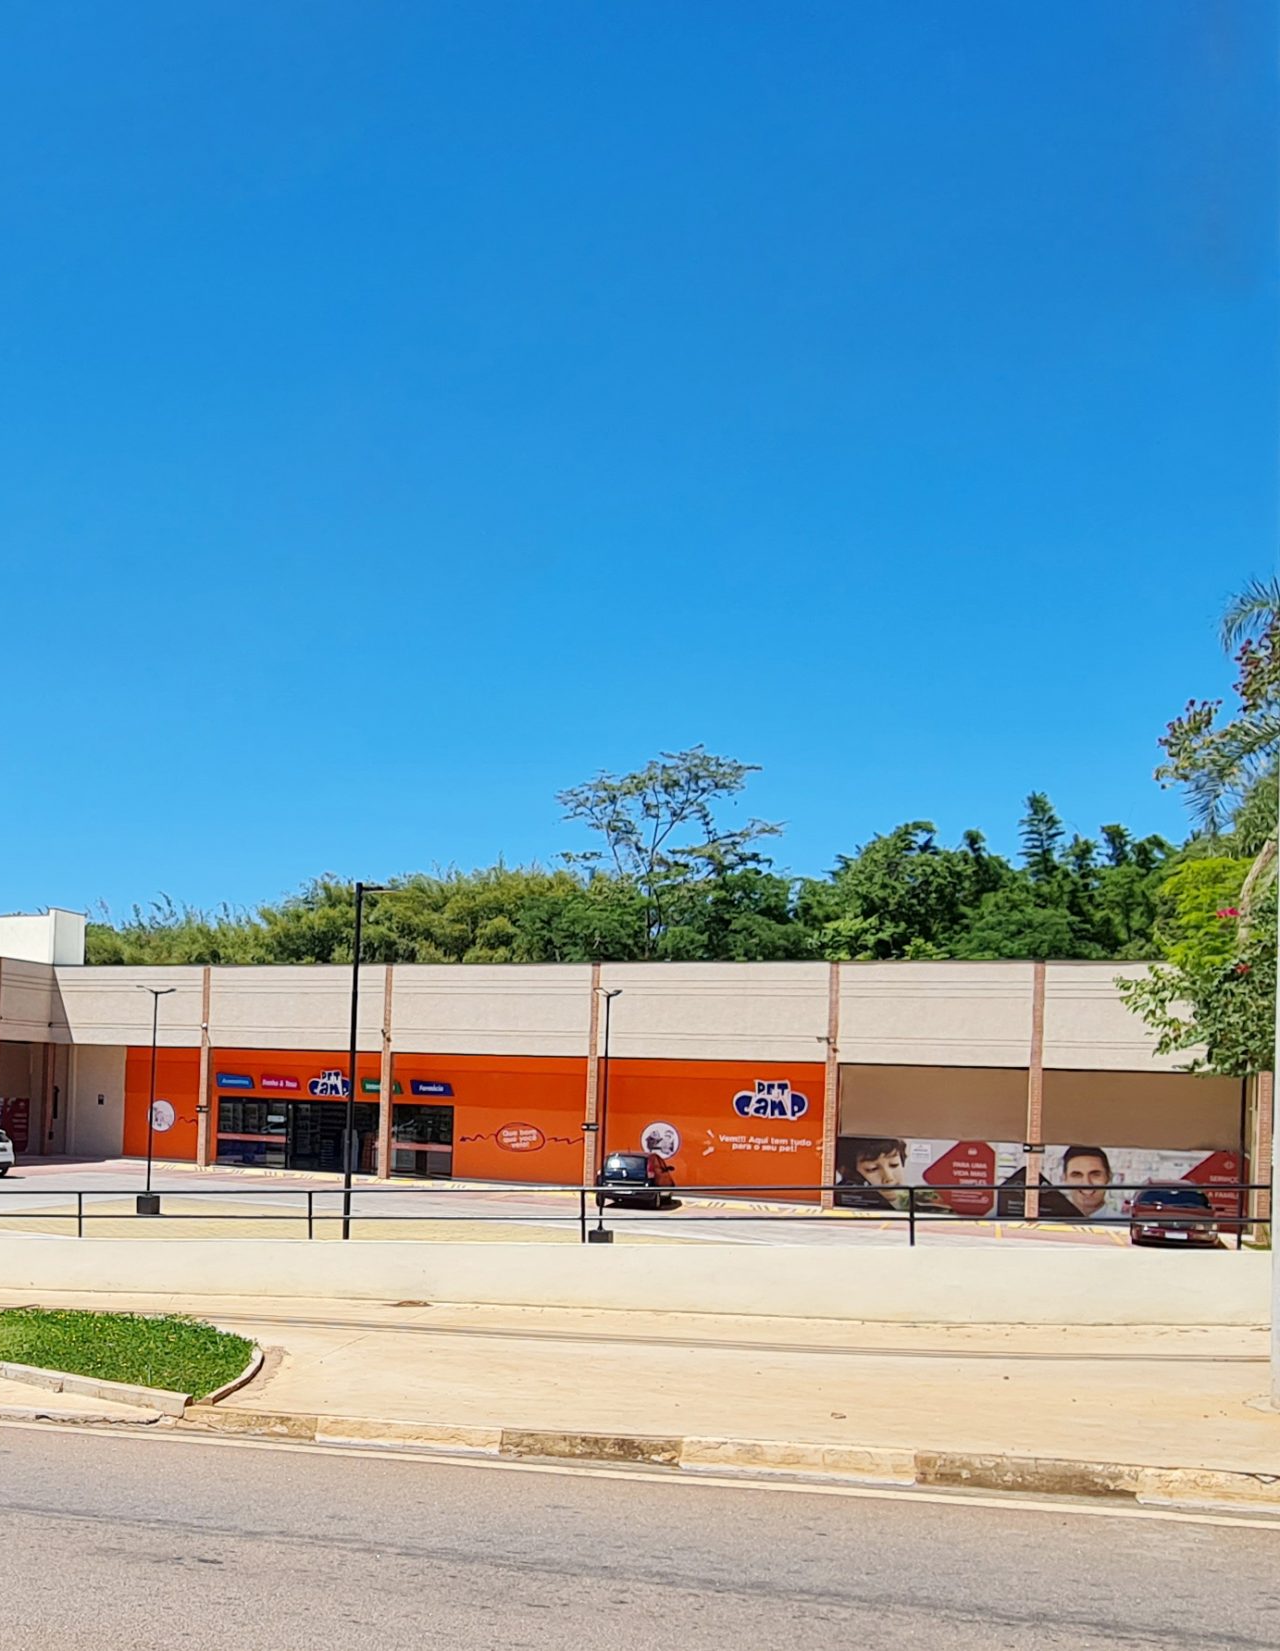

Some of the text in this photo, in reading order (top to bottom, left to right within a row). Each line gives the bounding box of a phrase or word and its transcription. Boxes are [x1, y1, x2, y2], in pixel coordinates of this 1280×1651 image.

[756, 1082, 789, 1095] PET
[749, 1136, 769, 1145] Aqui
[771, 1137, 788, 1145] tem
[790, 1138, 812, 1146] tudo
